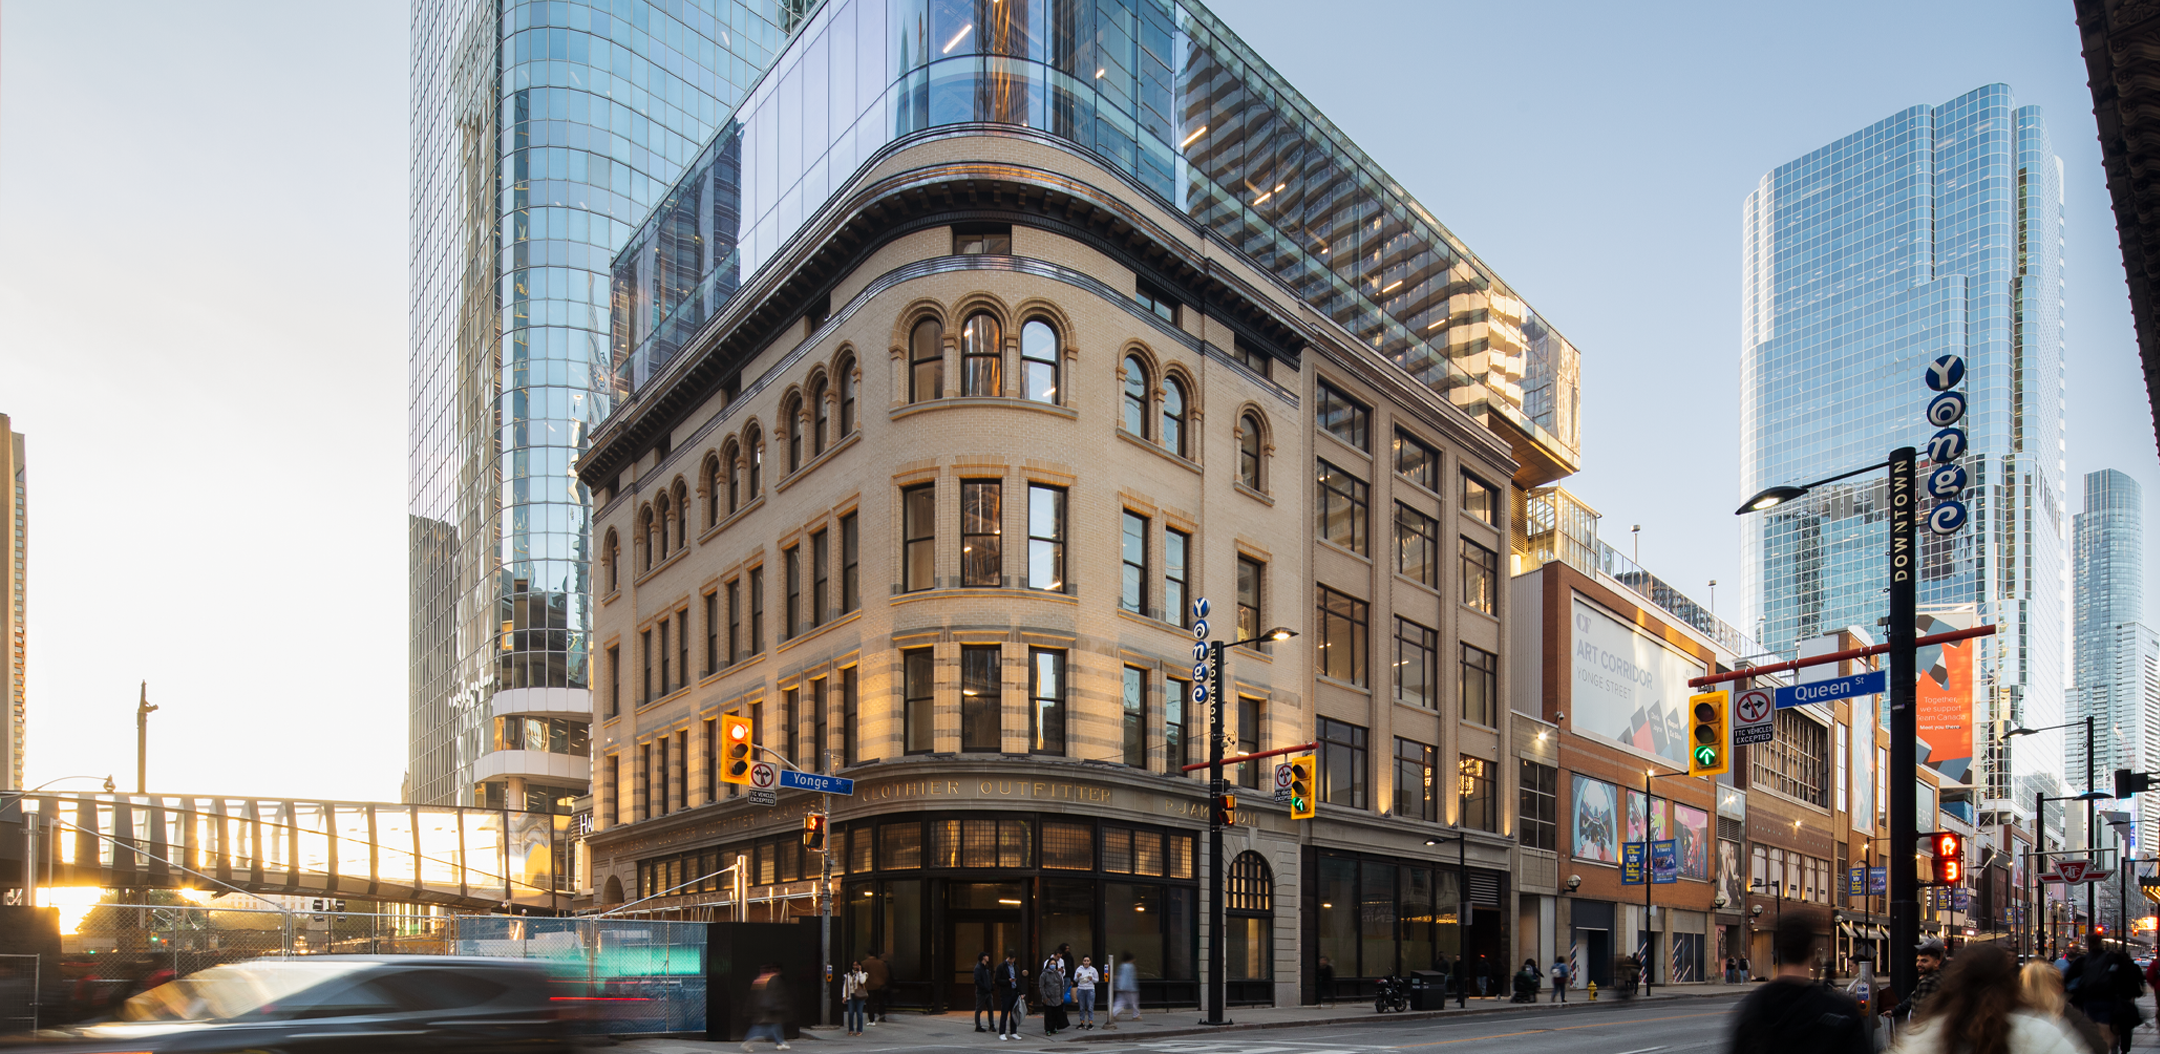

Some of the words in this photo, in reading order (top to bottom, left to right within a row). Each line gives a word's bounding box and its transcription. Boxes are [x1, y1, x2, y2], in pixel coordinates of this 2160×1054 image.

[1926, 355, 1966, 535] Yonge
[1894, 460, 1908, 582] DOWNTOWN
[1575, 612, 1592, 635] CF
[1192, 597, 1210, 704] Yonge
[1576, 638, 1598, 665] ART
[1601, 650, 1653, 690] CORRIDOR
[1577, 666, 1604, 689] YONGE
[1606, 680, 1632, 700] STREET
[1795, 681, 1850, 701] Queen
[1855, 676, 1865, 686] St
[1924, 696, 1958, 705] Together,
[1933, 705, 1962, 713] support
[1916, 714, 1936, 722] Team
[1736, 732, 1772, 744] EXCEPTED
[1747, 725, 1773, 735] VEHICLES
[793, 773, 829, 789] Yonge
[863, 781, 959, 801] CLOTHIER
[980, 781, 1111, 803] OUTFITTER
[1917, 807, 1932, 829] ERS
[1946, 861, 1957, 880] 3
